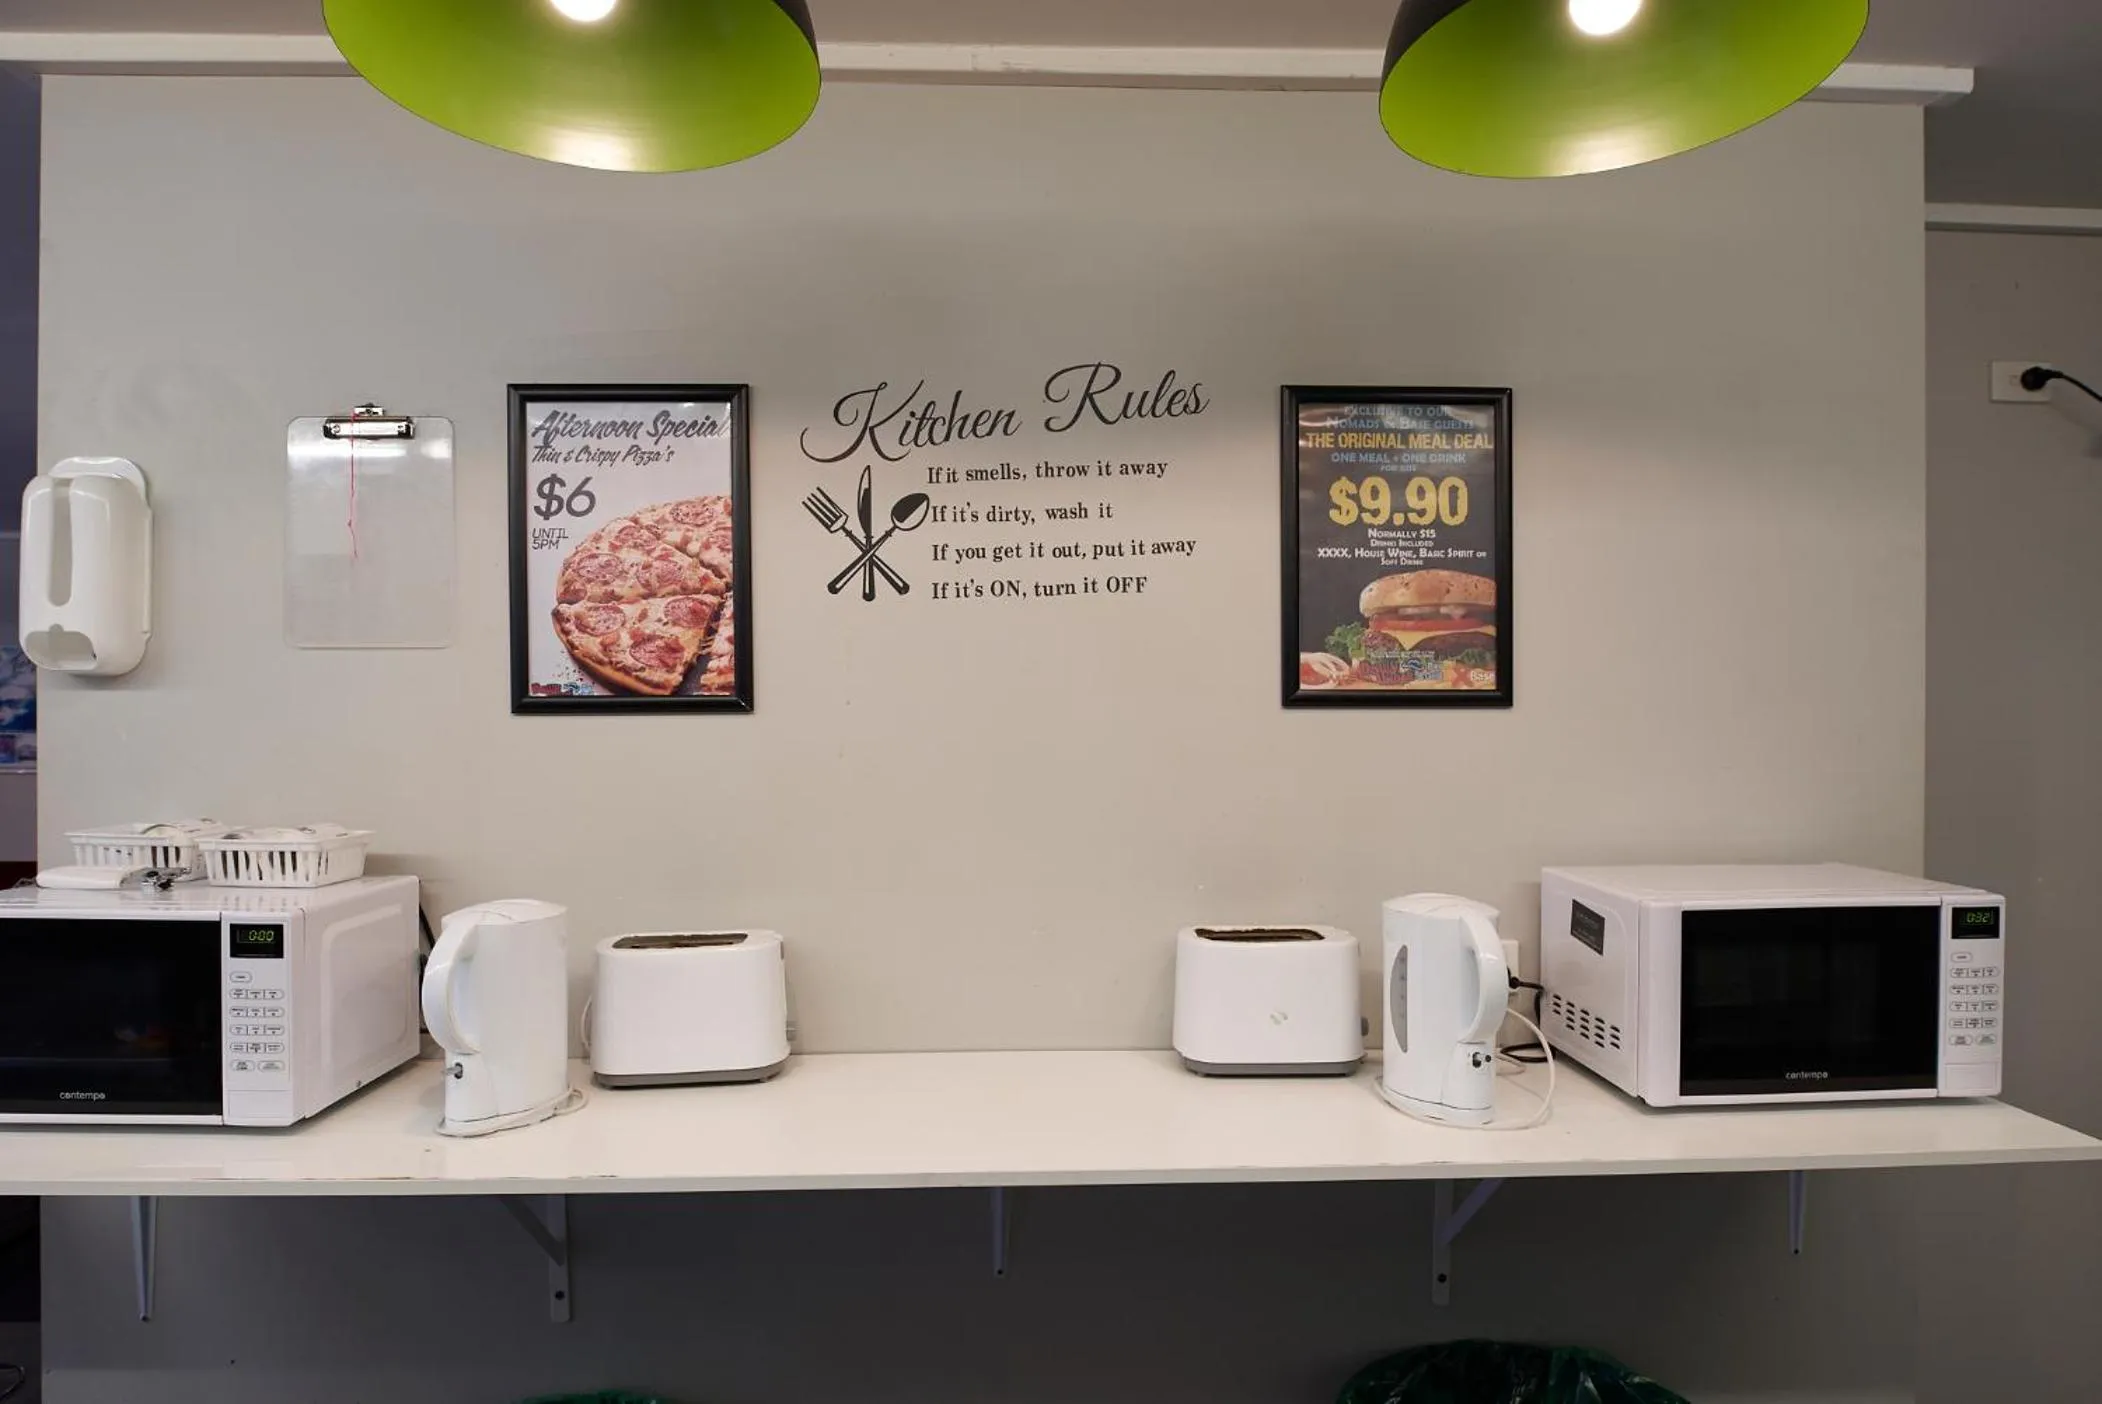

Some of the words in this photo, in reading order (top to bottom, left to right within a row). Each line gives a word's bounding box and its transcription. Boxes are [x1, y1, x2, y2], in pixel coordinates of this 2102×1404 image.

[801, 379, 1022, 463] Kitchen
[1043, 362, 1210, 433] Rules
[1408, 406, 1423, 416] TO
[531, 410, 644, 448] Afternoon
[1306, 432, 1335, 448] THE
[1338, 432, 1406, 449] ORIGINAL
[1408, 433, 1451, 449] MEAL
[1454, 433, 1494, 449] DEAL
[532, 445, 562, 463] Thin
[575, 446, 622, 467] Crispy
[622, 445, 675, 467] Pizza's
[1331, 453, 1357, 463] ONE
[1358, 453, 1391, 463] MEAL
[1401, 453, 1428, 463] ONE
[1429, 453, 1466, 463] DRINK
[928, 467, 943, 483] If
[946, 467, 959, 483] it
[965, 463, 1027, 481] smells,
[1035, 461, 1090, 478] throw
[1097, 460, 1112, 476] it
[1119, 462, 1168, 478] away
[533, 473, 596, 520] $6
[1329, 476, 1468, 526] $9.90
[931, 505, 947, 522] If
[952, 501, 979, 522] it's
[986, 505, 1035, 525] dirty,
[1045, 502, 1088, 520] wash
[1098, 502, 1113, 518] it
[532, 527, 569, 539] UNTIL
[1367, 528, 1417, 539] NORMALLY
[1419, 529, 1437, 539] $15
[532, 538, 560, 550] 5PM
[932, 544, 949, 561] If
[955, 546, 986, 564] you
[992, 543, 1021, 562] get
[1029, 541, 1044, 558] it
[1052, 542, 1086, 559] out,
[1092, 542, 1124, 559] put
[1131, 540, 1145, 555] it
[1151, 540, 1196, 556] away
[1399, 539, 1434, 547] INCLUDED
[1317, 548, 1352, 558] XXXX,
[1354, 548, 1385, 558] HOUSE
[1387, 548, 1417, 559] WINE,
[932, 582, 949, 599] If
[954, 578, 983, 598] it's
[990, 579, 1027, 598] ON,
[1034, 581, 1077, 597] turn
[1083, 577, 1099, 593] it
[1106, 576, 1147, 593] OFF
[59, 1091, 106, 1102] contempo
